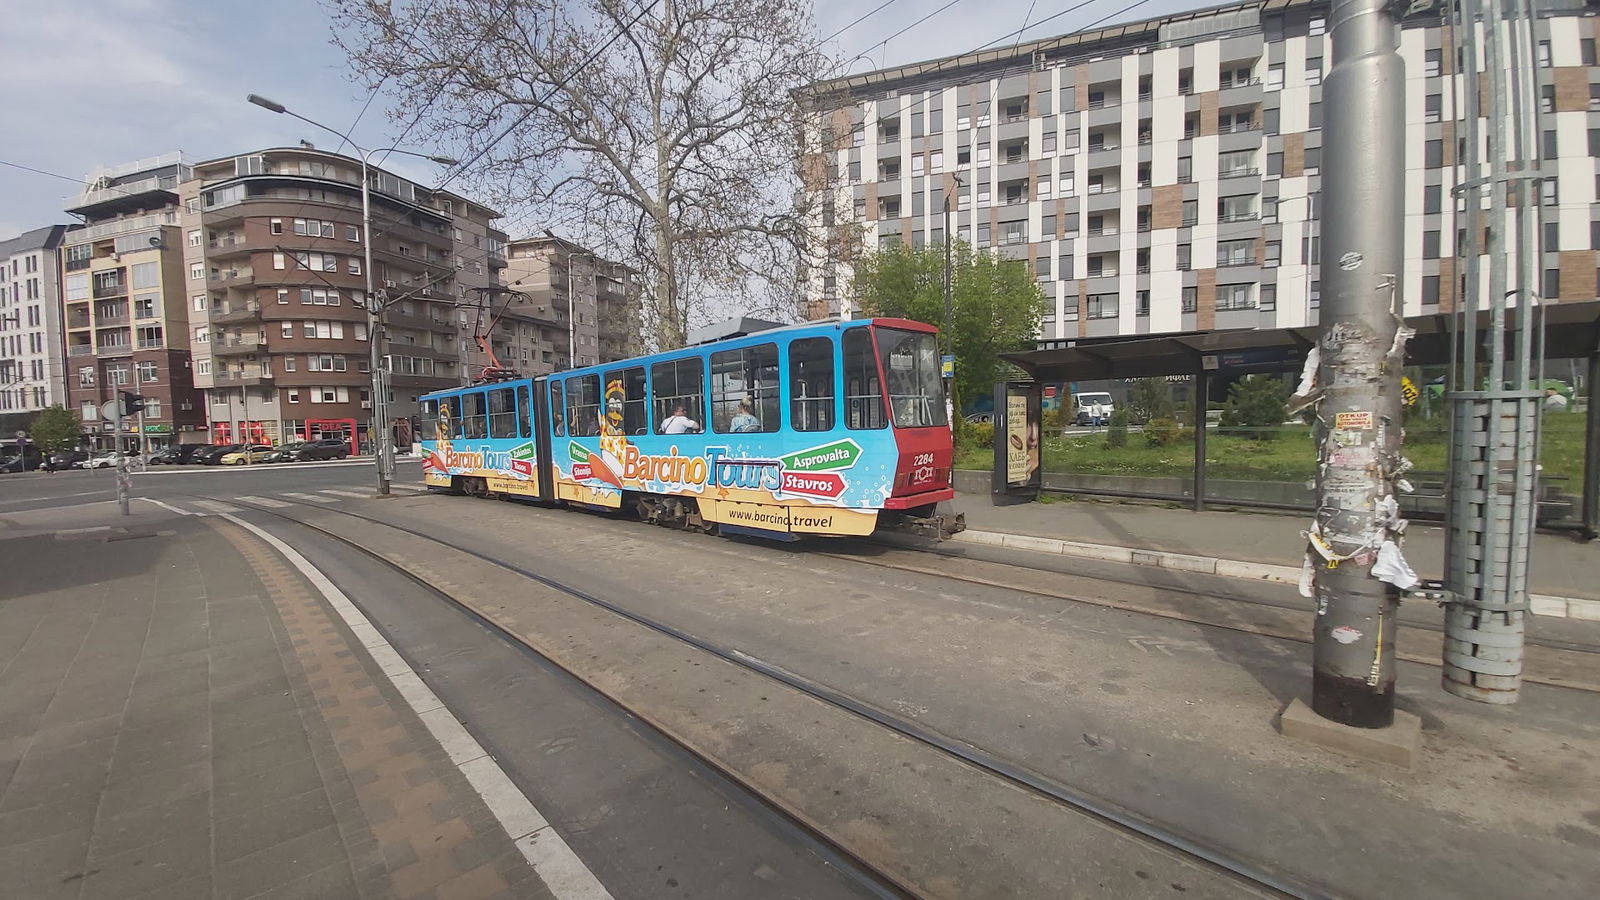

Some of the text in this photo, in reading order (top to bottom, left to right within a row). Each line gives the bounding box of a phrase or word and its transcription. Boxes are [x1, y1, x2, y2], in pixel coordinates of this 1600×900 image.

[793, 448, 850, 469] Asprovalta
[913, 453, 934, 466] 2284
[785, 475, 833, 492] Stavros
[728, 508, 833, 528] www.barcino.travel
